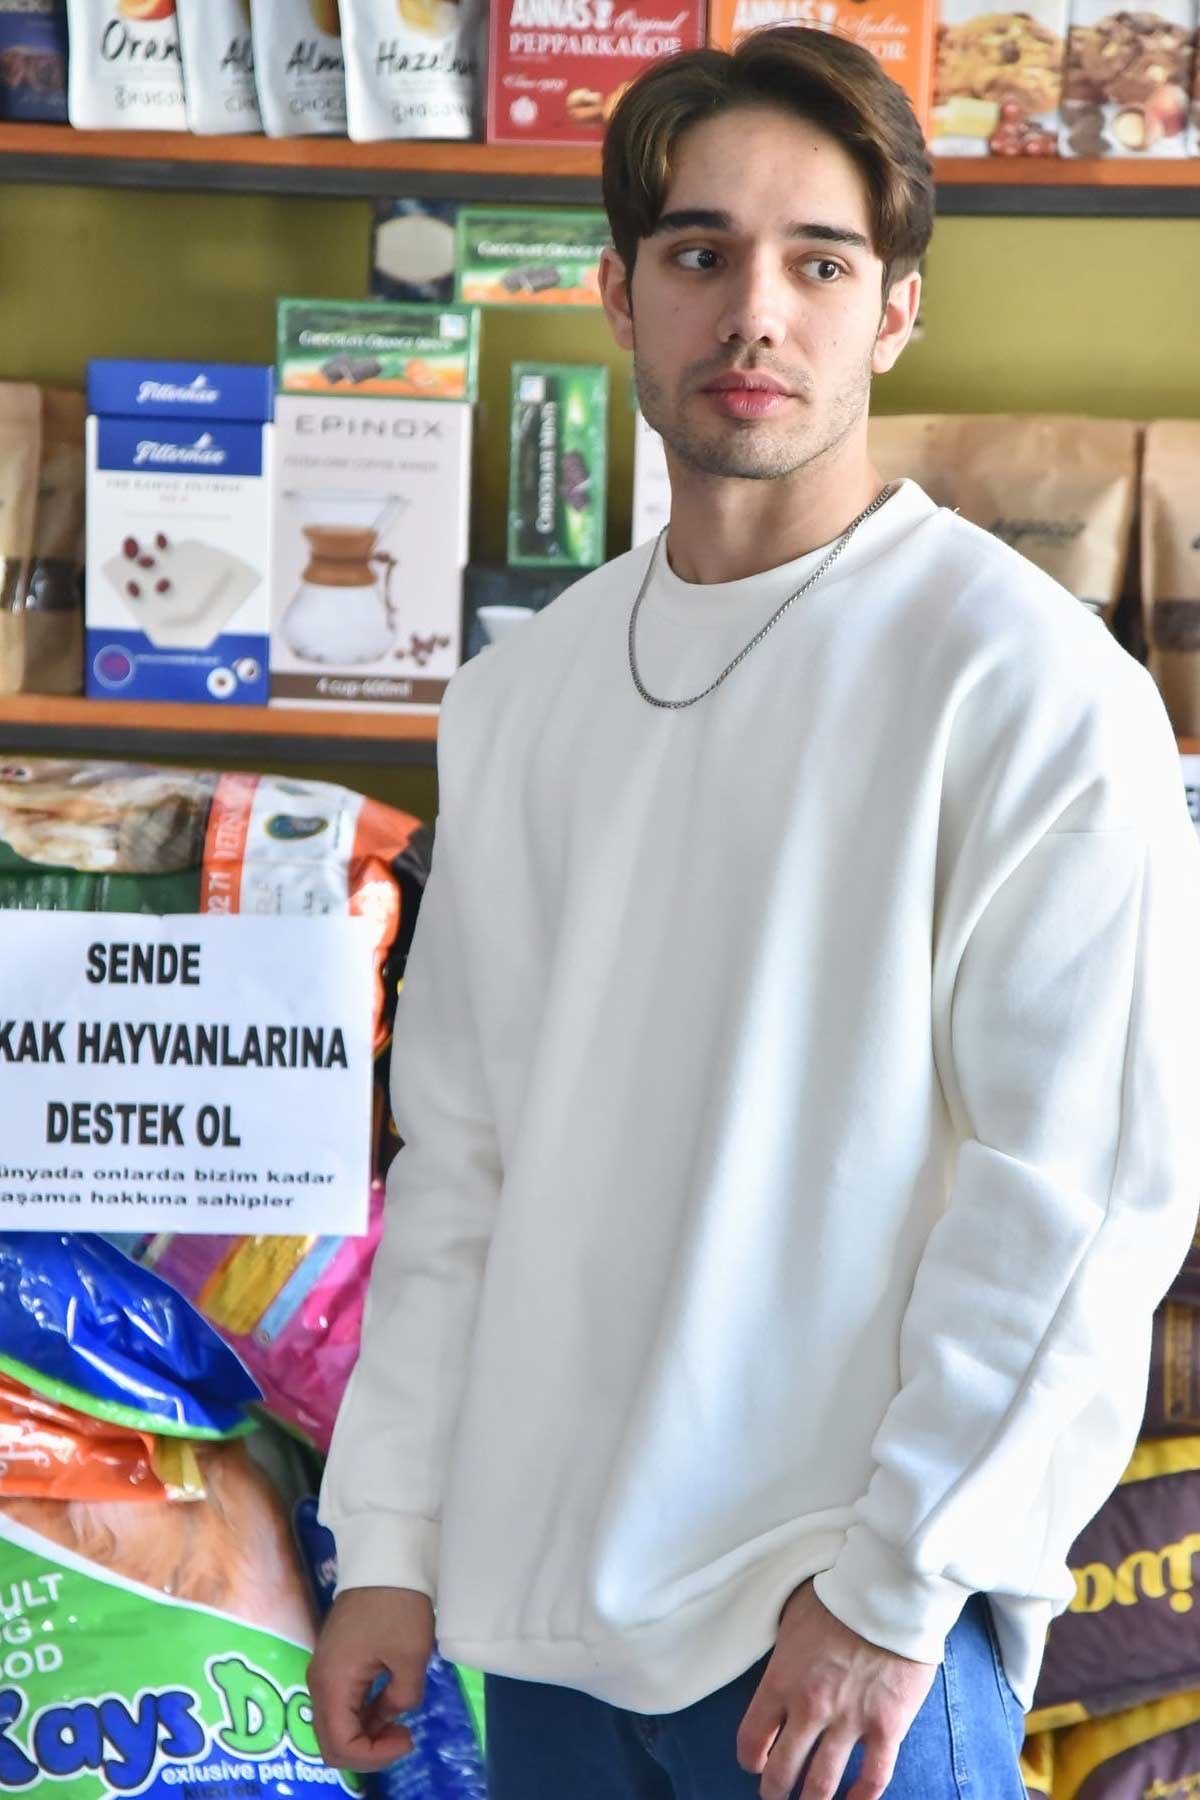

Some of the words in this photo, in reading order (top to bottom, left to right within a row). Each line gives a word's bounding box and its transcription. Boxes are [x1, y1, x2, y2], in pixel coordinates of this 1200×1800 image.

[219, 38, 254, 73] Al
[295, 415, 444, 439] EPINOX
[86, 943, 201, 985] SENDE
[77, 1021, 349, 1070] HAYVANLARINA
[46, 1101, 186, 1147] DESTEK
[195, 1105, 242, 1148] OL
[93, 1166, 186, 1182] onlarda
[194, 1167, 259, 1183] bizim
[267, 1168, 336, 1185] kadar
[90, 1190, 188, 1207] hakkına
[196, 1191, 295, 1210] sahipler
[0, 1617, 33, 1645] G
[0, 1644, 64, 1680] OD
[160, 1760, 256, 1785] exlusive
[258, 1760, 294, 1784] pet
